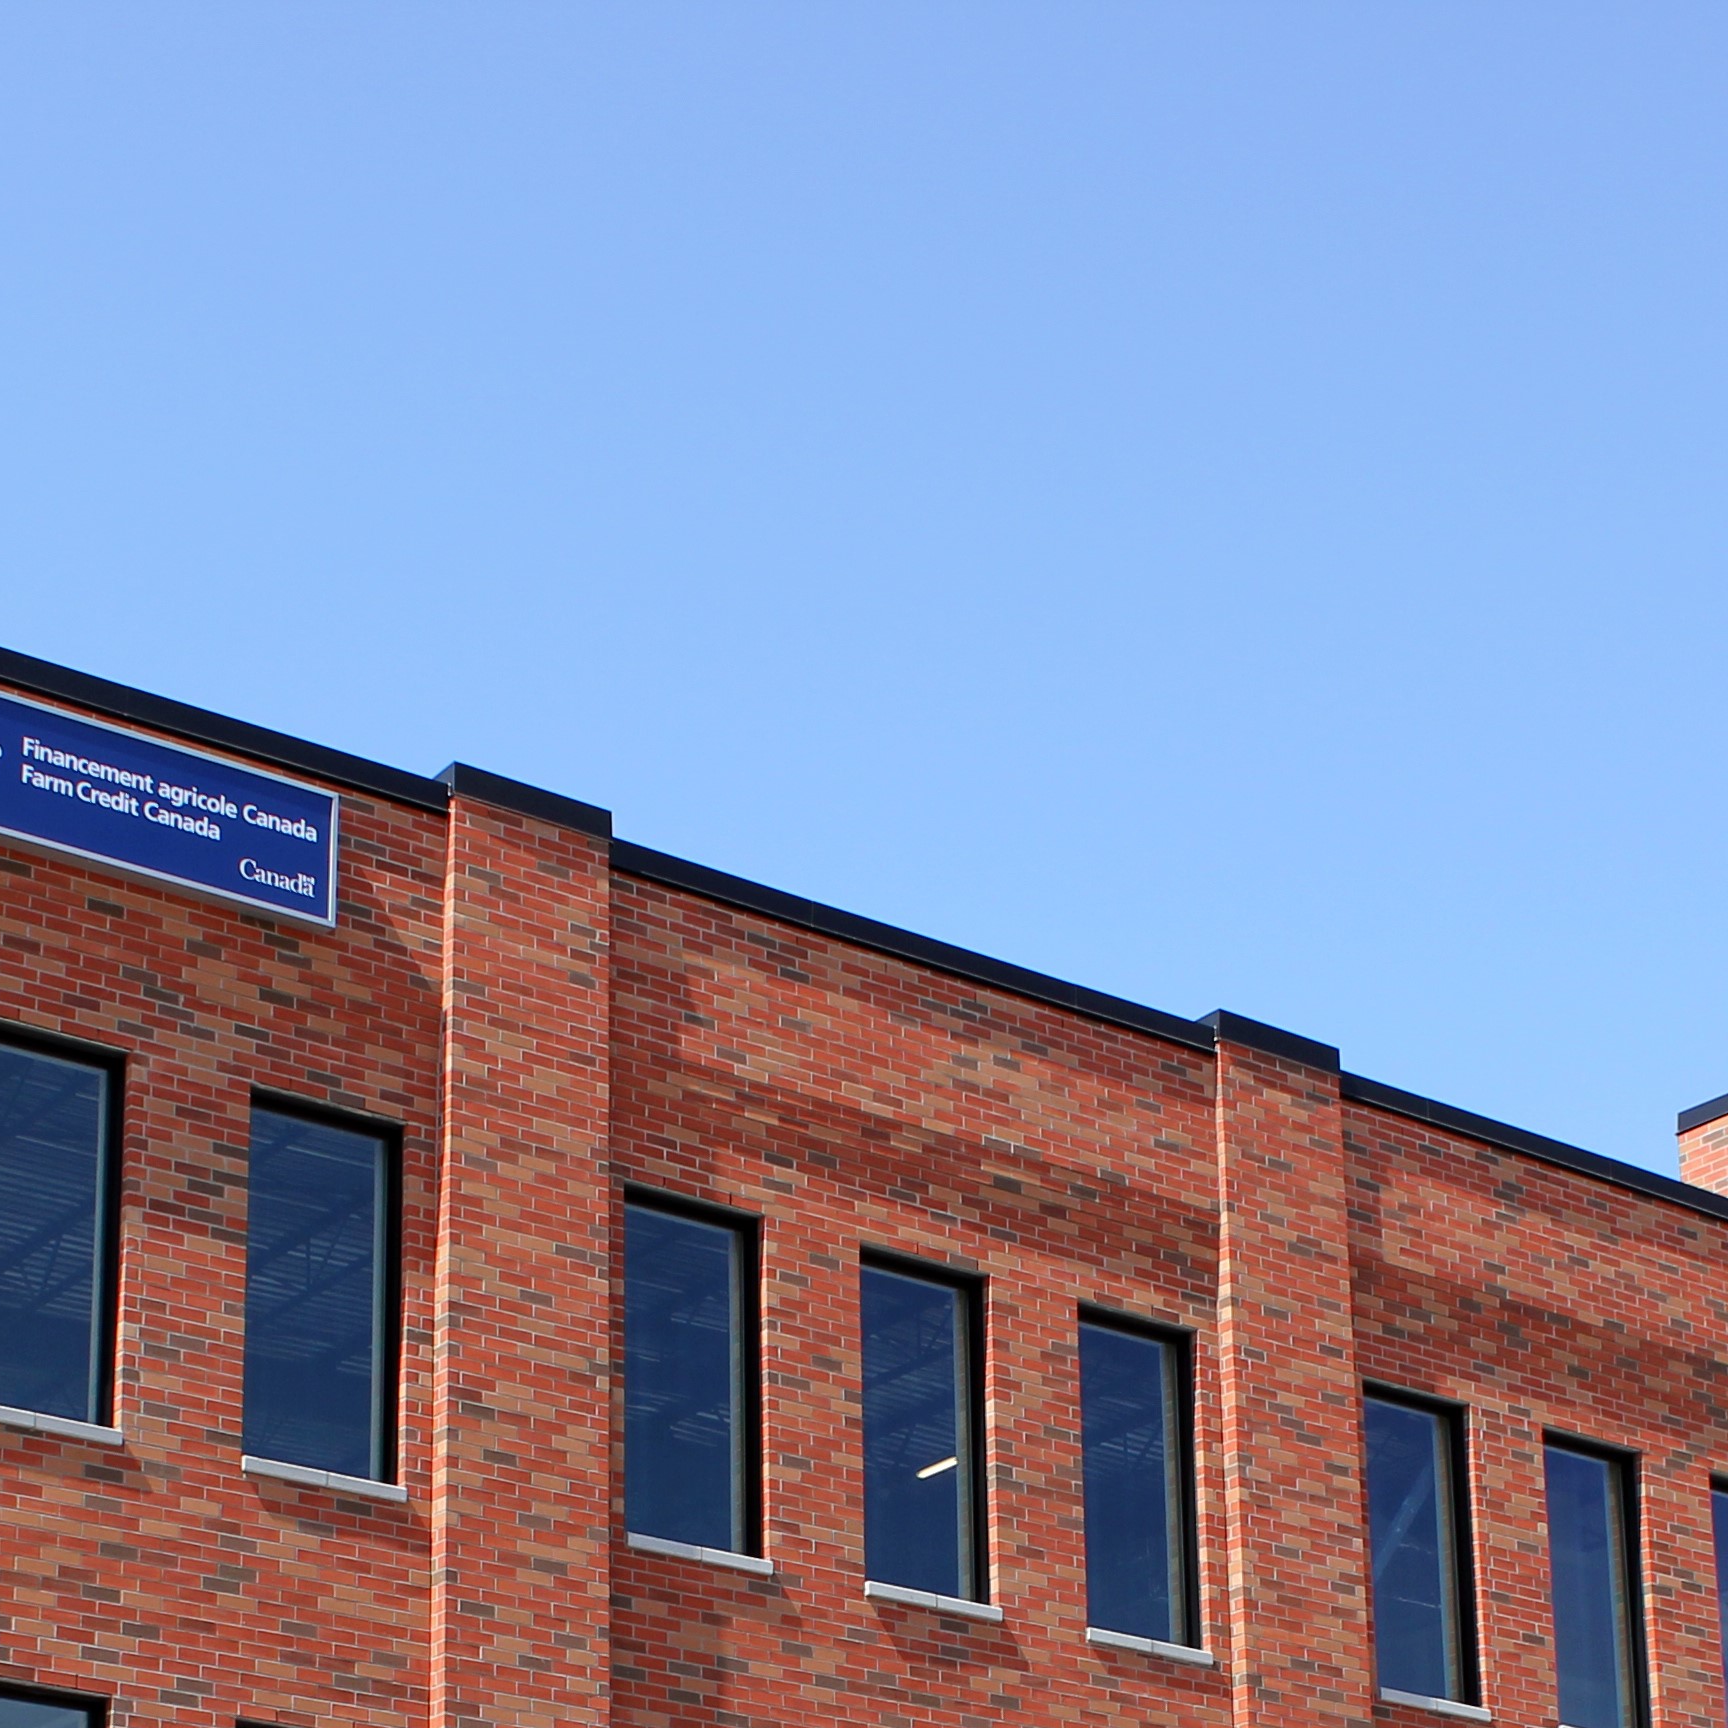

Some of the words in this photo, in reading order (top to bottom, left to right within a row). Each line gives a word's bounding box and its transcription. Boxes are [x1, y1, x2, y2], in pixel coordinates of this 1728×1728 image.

[21, 763, 73, 798] Farm
[76, 781, 140, 817] Credit
[143, 801, 222, 841] Canada
[22, 736, 154, 794] Financement
[158, 781, 238, 819] agricole
[243, 803, 318, 843] Canada
[239, 857, 317, 898] Canada
